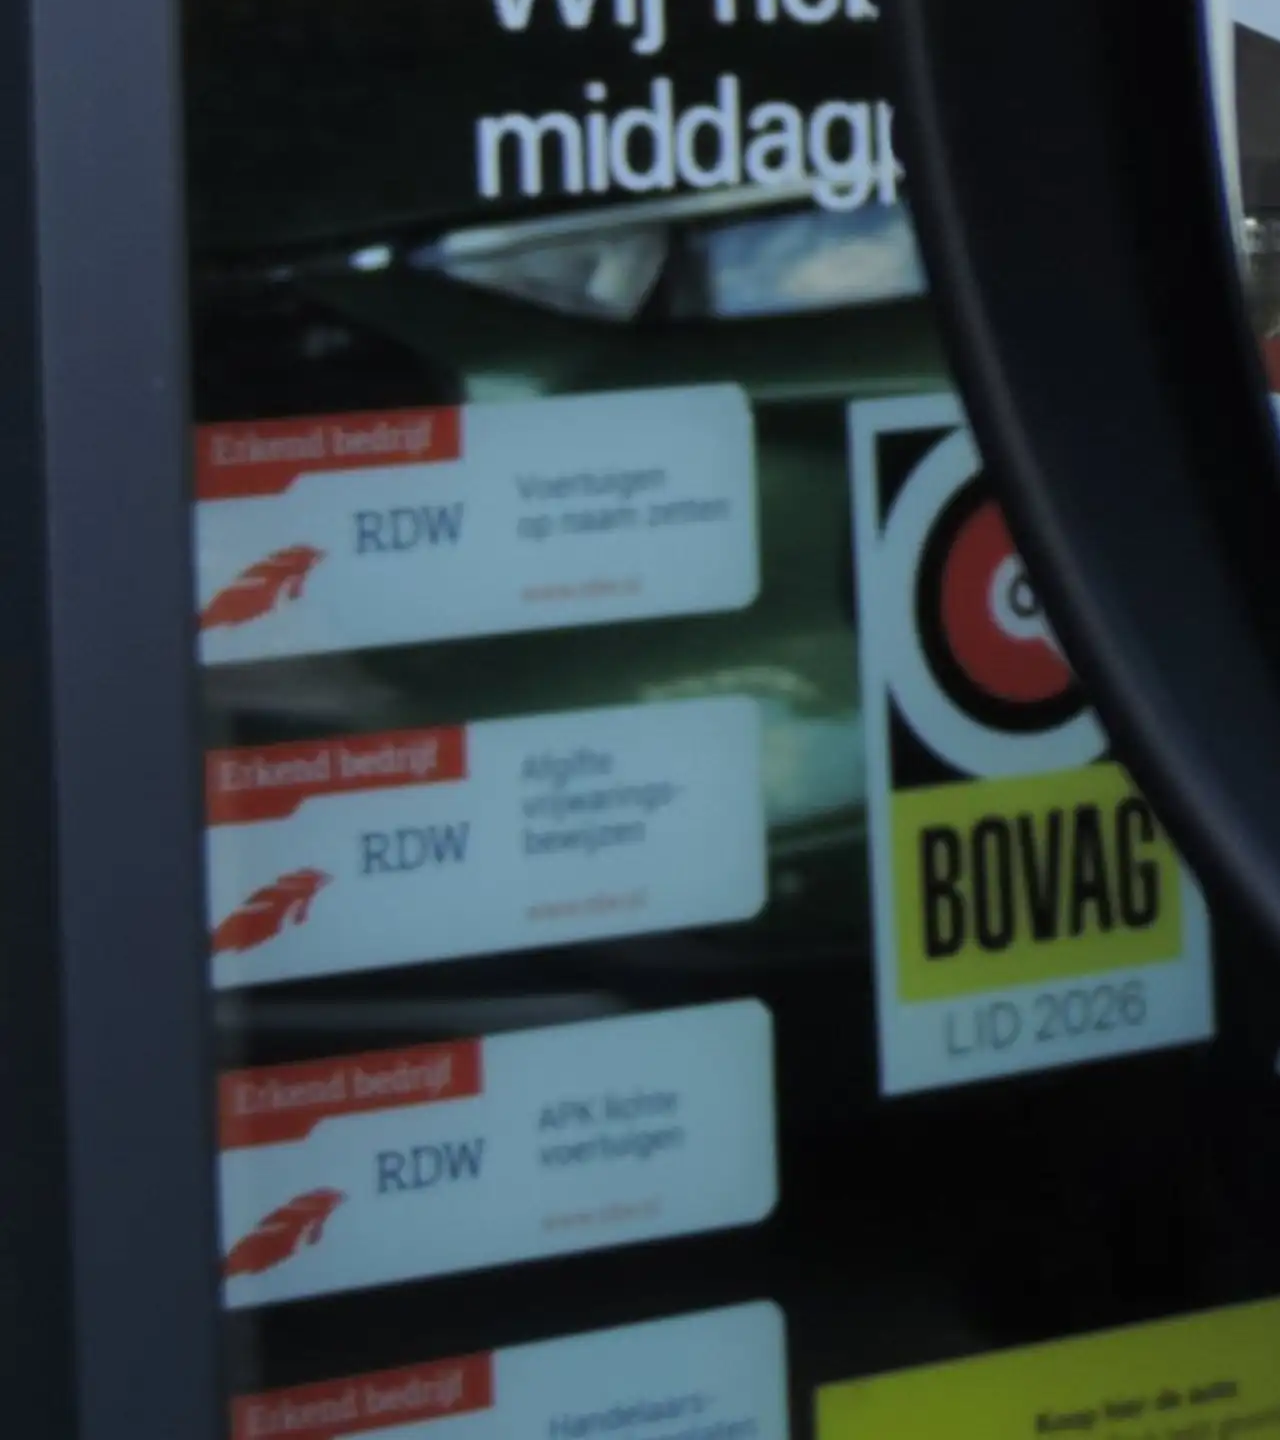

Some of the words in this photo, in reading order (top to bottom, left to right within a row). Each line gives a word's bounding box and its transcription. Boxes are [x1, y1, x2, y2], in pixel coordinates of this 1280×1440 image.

[353, 502, 466, 554] RDW
[359, 821, 472, 875] RDW
[918, 796, 1160, 962] BOVAG
[944, 998, 1023, 1057] LID
[1034, 980, 1148, 1044] 2026
[375, 1137, 487, 1194] RDW
